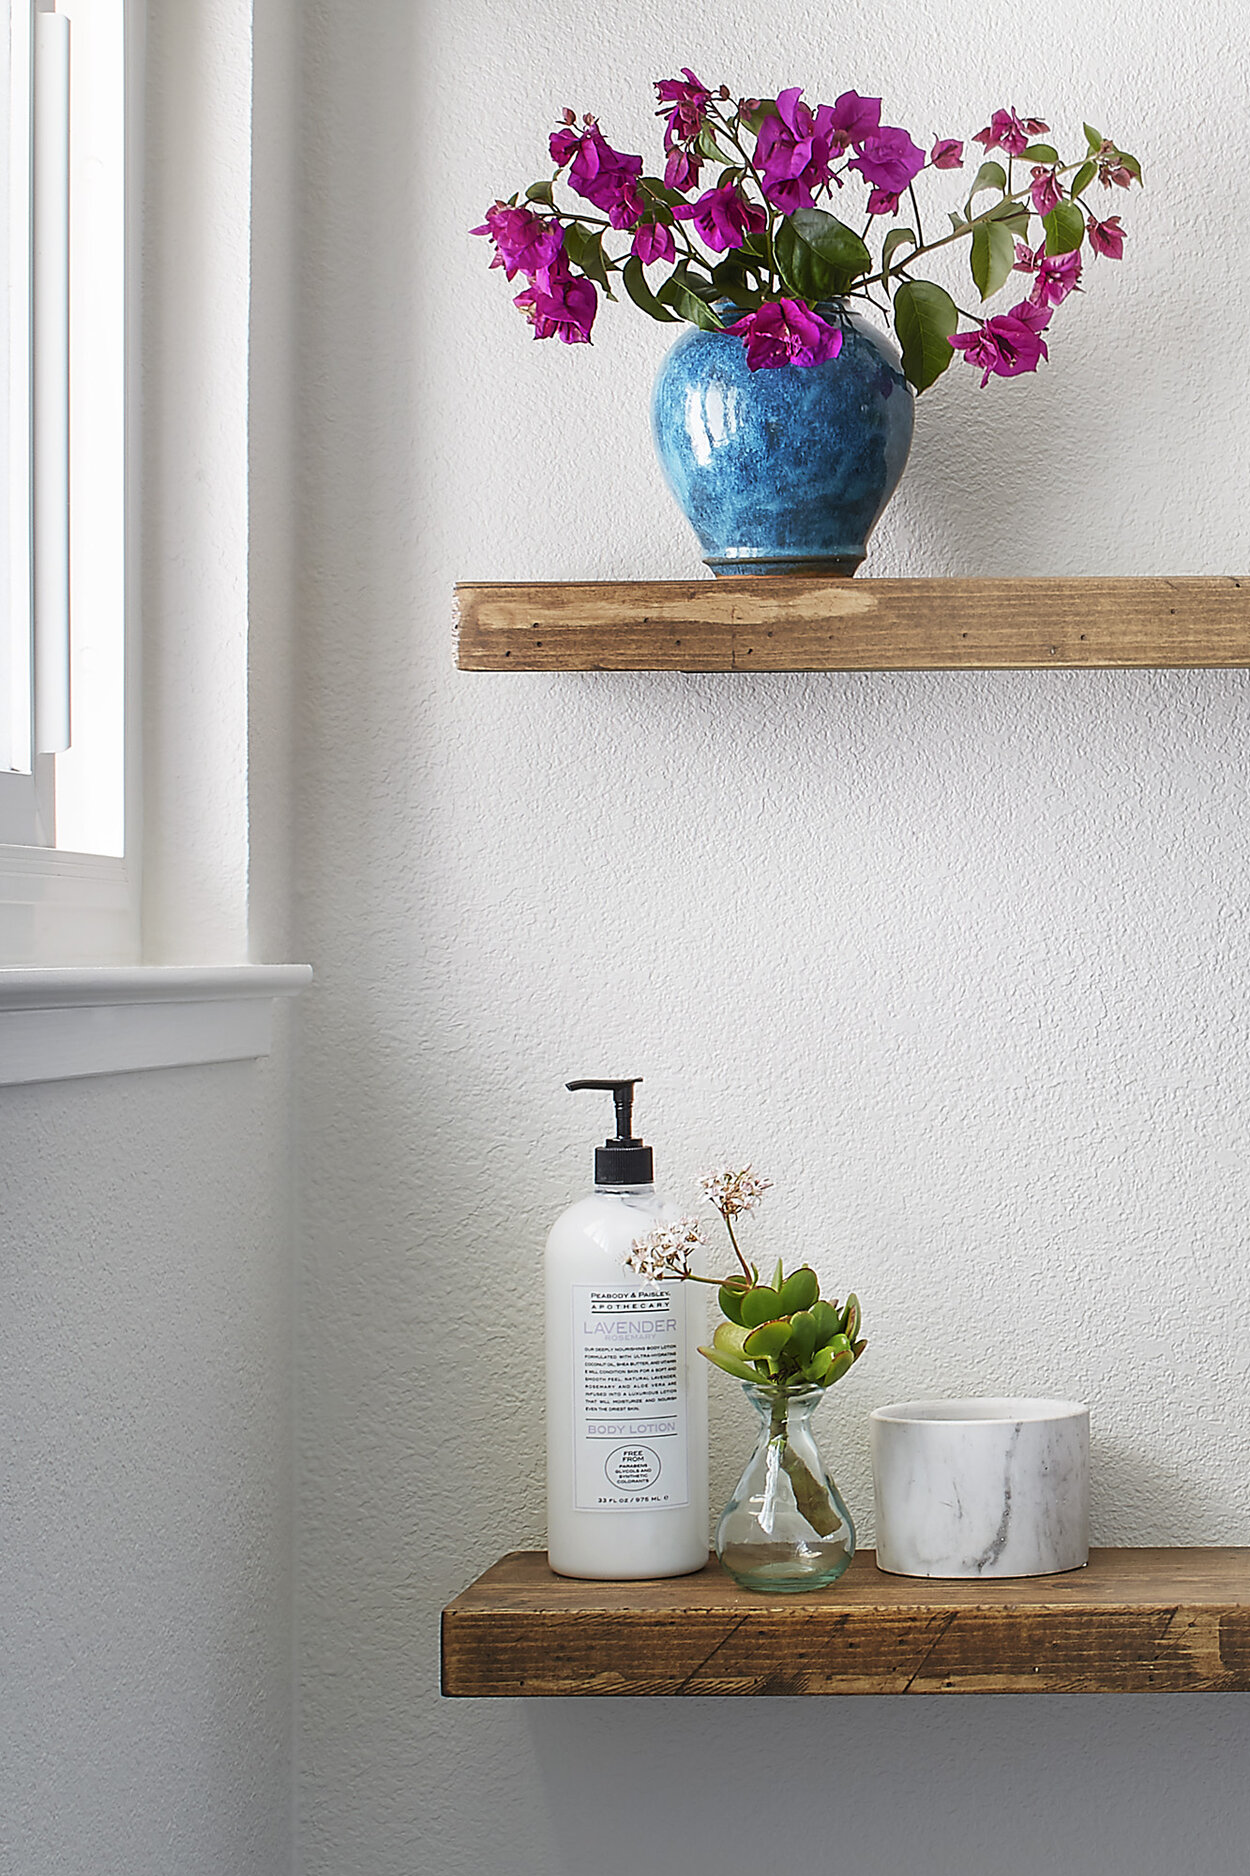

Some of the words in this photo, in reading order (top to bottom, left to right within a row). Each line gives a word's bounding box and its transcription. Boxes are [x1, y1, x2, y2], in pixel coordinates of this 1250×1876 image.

[591, 1302, 670, 1310] APOTHECARY
[584, 1319, 676, 1334] LAVENDER
[588, 1425, 625, 1434] BODY
[630, 1422, 675, 1434] LOTION
